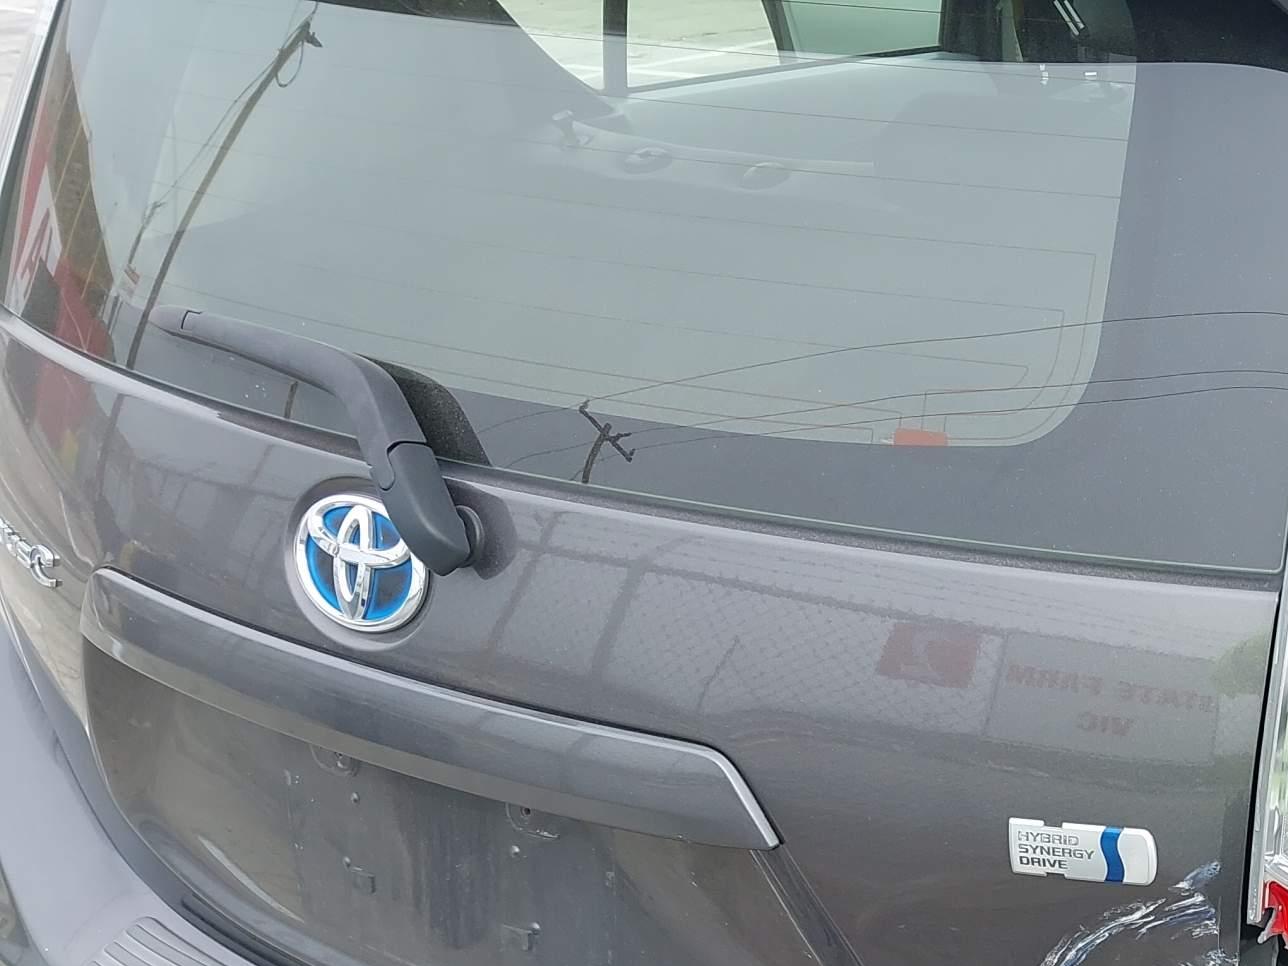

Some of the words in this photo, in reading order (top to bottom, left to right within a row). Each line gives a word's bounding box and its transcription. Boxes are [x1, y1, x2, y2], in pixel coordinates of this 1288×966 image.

[1018, 830, 1080, 846] HYBRID
[1018, 844, 1095, 860] SYNERGY
[1019, 856, 1069, 870] DRIVE
